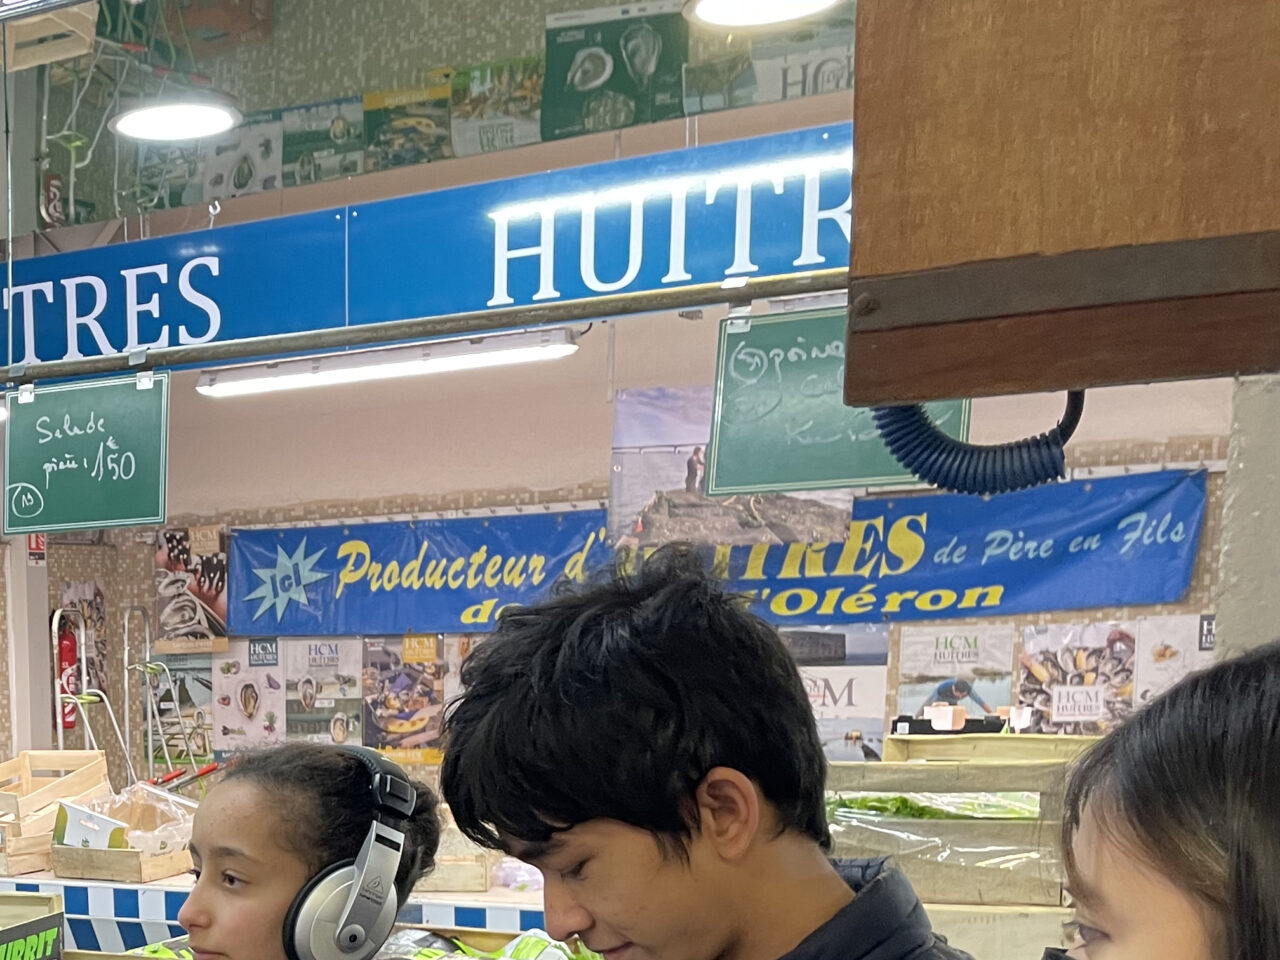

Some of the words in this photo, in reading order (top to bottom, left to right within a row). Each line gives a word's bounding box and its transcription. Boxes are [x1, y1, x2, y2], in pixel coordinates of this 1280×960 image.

[36, 411, 105, 444] Salade
[336, 540, 547, 599] Producteur
[933, 535, 966, 566] de
[981, 528, 1054, 566] Père
[1069, 532, 1102, 555] en
[1117, 511, 1186, 555] Fils
[250, 642, 277, 654] HCM
[308, 643, 339, 656] HCM
[934, 635, 979, 650] HCM
[1056, 690, 1100, 703] HCM
